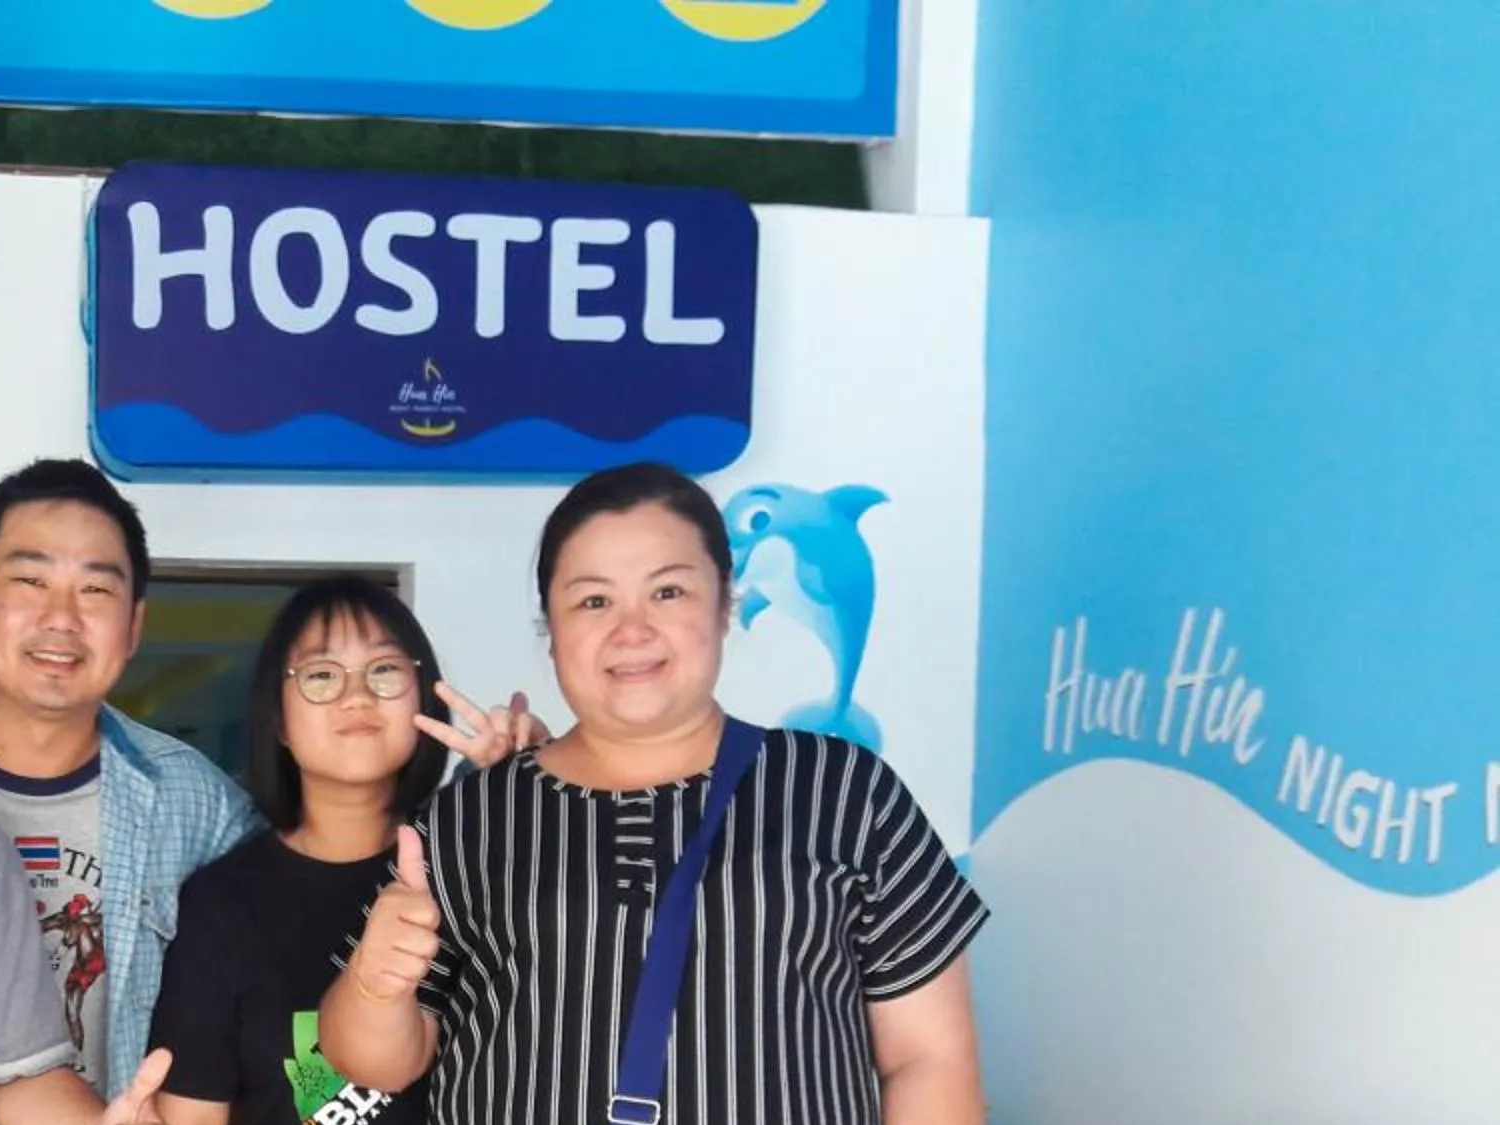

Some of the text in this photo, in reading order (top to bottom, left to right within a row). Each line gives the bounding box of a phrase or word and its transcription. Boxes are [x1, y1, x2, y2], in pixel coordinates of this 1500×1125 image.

[127, 201, 725, 345] HOSTEL
[1042, 615, 1149, 755] Hua
[1156, 605, 1268, 765] Hin
[1276, 734, 1459, 865] NIGHT
